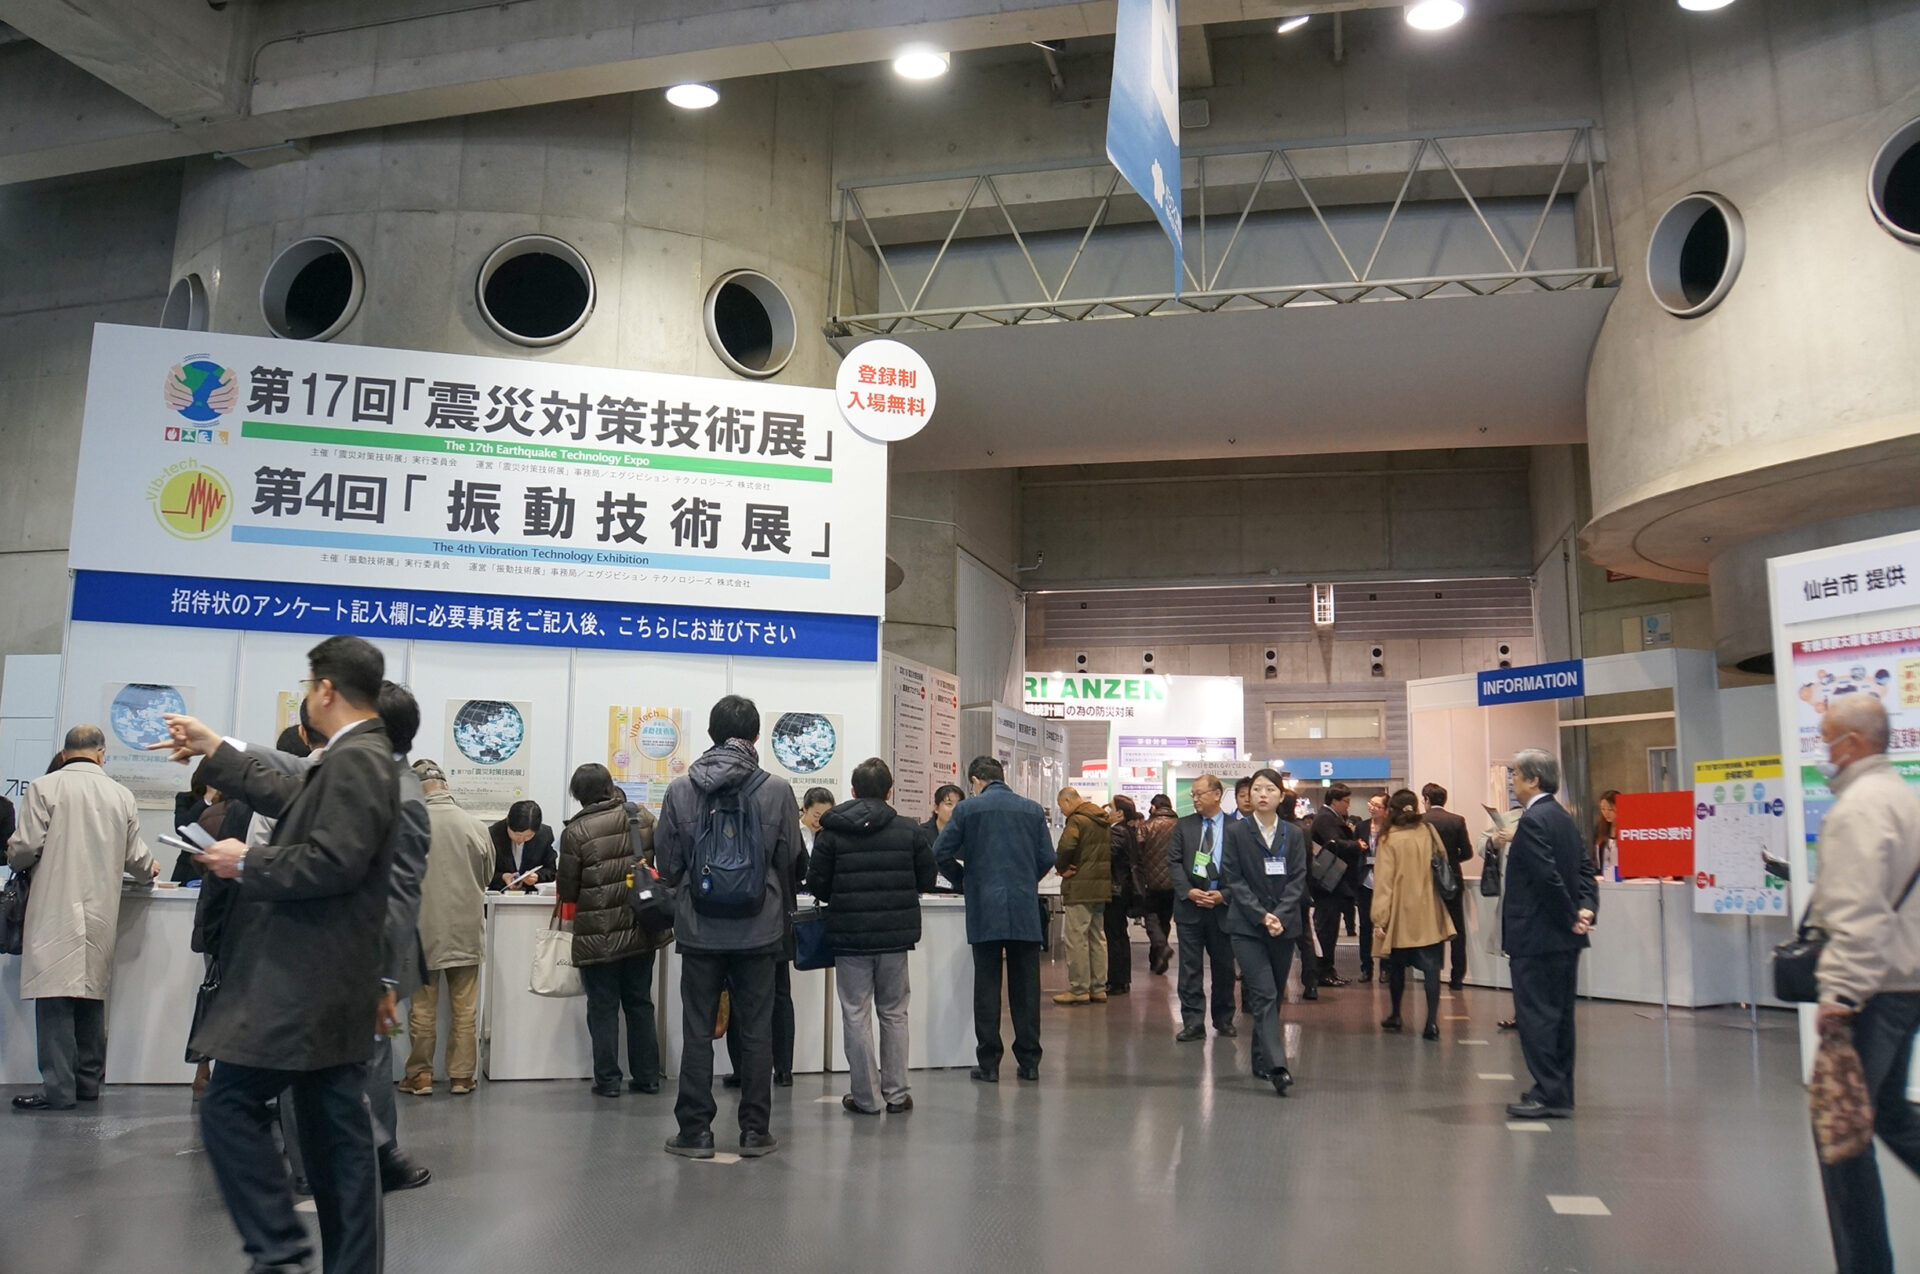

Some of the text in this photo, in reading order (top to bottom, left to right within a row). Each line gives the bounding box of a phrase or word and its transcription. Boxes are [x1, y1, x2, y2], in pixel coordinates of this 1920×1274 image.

[858, 364, 917, 389] 登録制
[247, 365, 833, 462] 第17回「震災対策技術展」
[847, 391, 926, 417] 入場無料
[444, 440, 650, 467] The 17th Earthquake Technology Expo
[146, 456, 198, 501] Vib-tech
[432, 541, 650, 566] The 4th Vibration Technology Exhibition
[1803, 565, 1906, 601] 仙台市 提供
[1060, 678, 1163, 700] ANZEN
[1483, 671, 1578, 696] INFORMATION
[1319, 761, 1334, 777] B
[1619, 826, 1693, 841] PRESS受付
